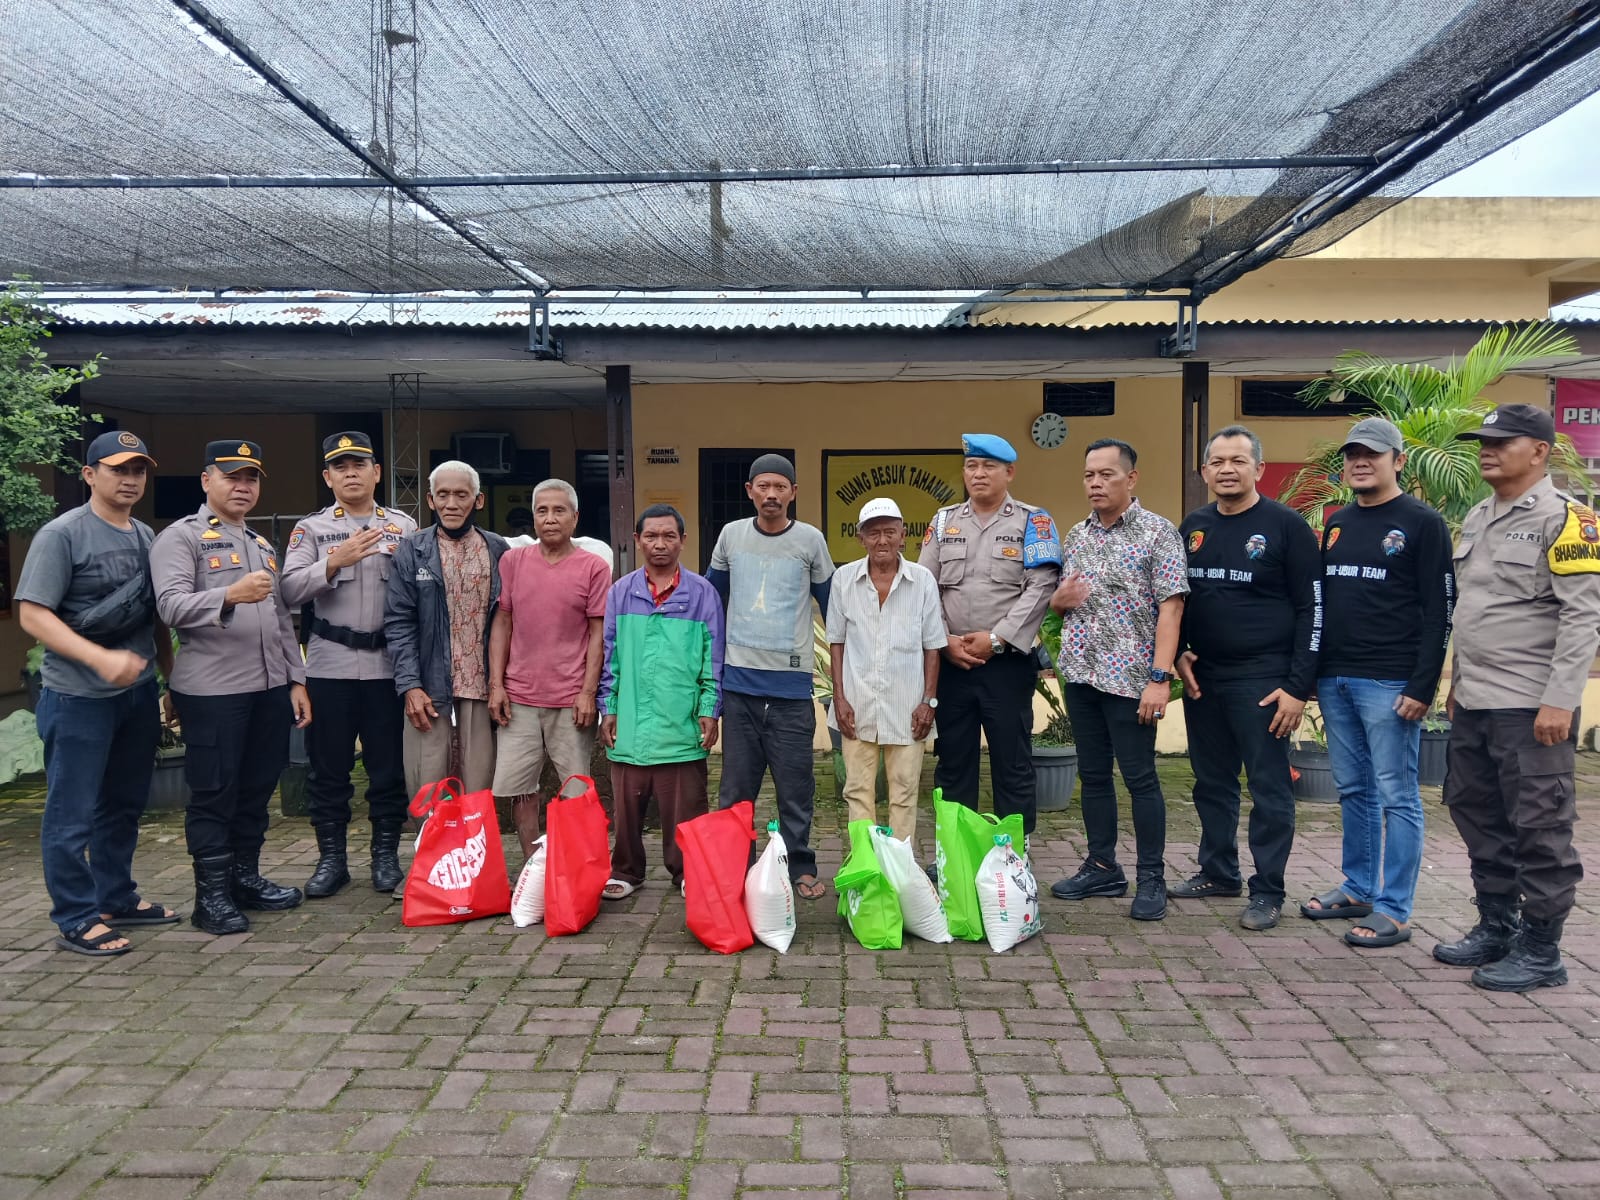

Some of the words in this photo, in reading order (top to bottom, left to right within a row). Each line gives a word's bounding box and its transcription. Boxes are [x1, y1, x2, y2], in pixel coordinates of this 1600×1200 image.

[650, 448, 675, 456] RUANG
[646, 457, 680, 465] TAHANAN
[836, 472, 872, 506] RUANG
[870, 464, 906, 487] BESUK
[910, 466, 956, 505] TAHANAN
[1505, 532, 1541, 542] POLRI
[1230, 569, 1252, 582] TEAM
[1362, 566, 1386, 580] TEAM
[1309, 629, 1321, 652] TEAM
